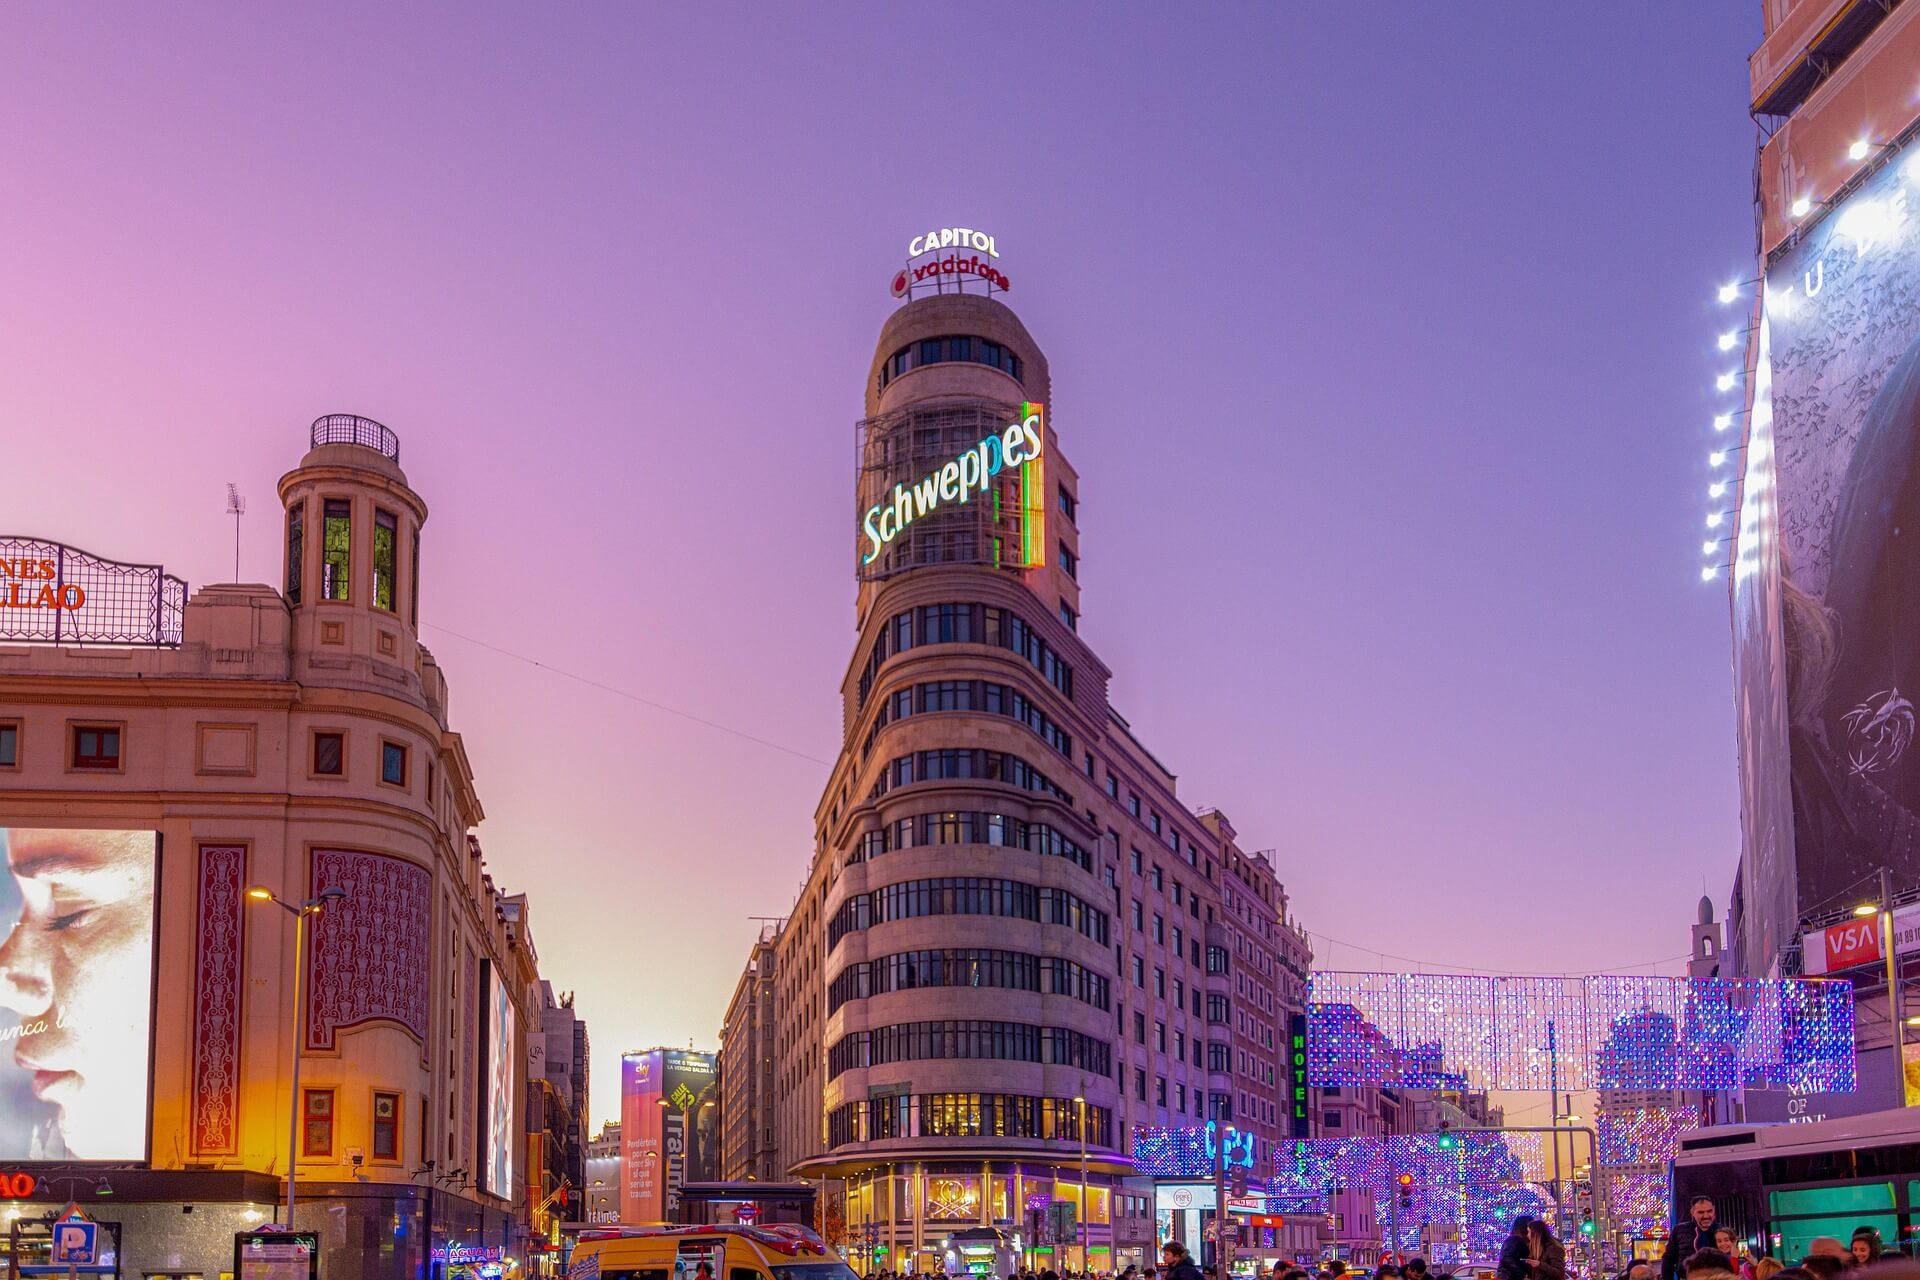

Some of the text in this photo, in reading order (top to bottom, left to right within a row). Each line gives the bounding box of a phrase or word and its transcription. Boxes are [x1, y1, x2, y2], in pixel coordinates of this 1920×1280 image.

[908, 227, 1000, 258] CAPITOL
[914, 255, 1010, 292] vodafone
[863, 414, 1042, 566] Schweppes
[0, 583, 86, 611] LAO
[1829, 924, 1875, 954] VSA
[1294, 1035, 1306, 1118] HOTEL
[670, 1083, 690, 1102] CALLE
[1787, 1098, 1807, 1115] OF
[60, 1227, 87, 1260] P
